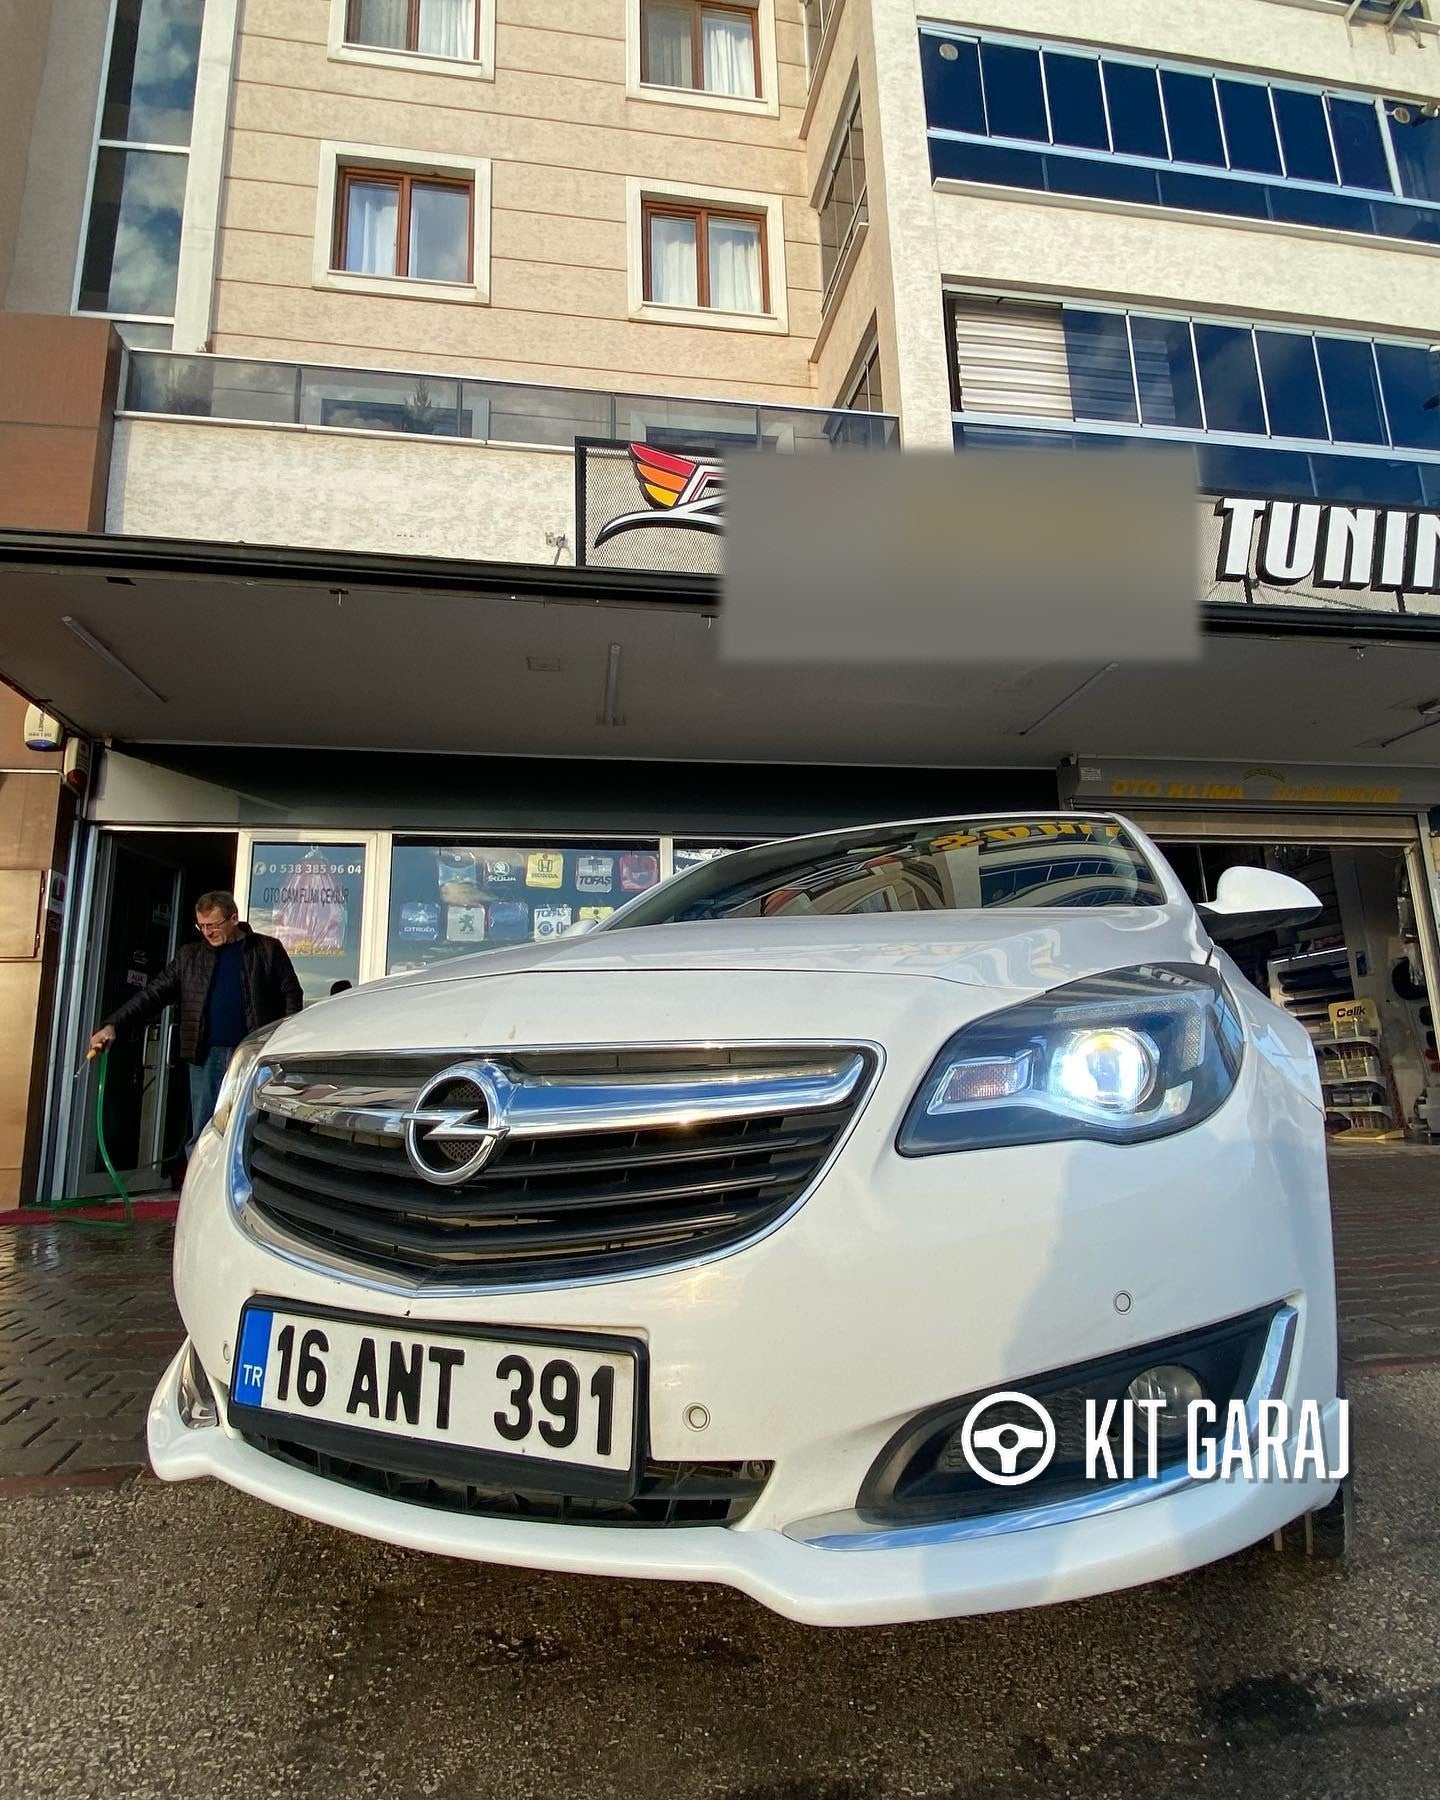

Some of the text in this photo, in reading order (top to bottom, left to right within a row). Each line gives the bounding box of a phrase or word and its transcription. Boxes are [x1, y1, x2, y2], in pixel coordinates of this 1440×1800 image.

[330, 863, 345, 874] 96
[347, 864, 362, 875] 04
[263, 887, 280, 903] OTO
[243, 1364, 262, 1387] TR
[277, 1325, 615, 1456] 16 ANT 391
